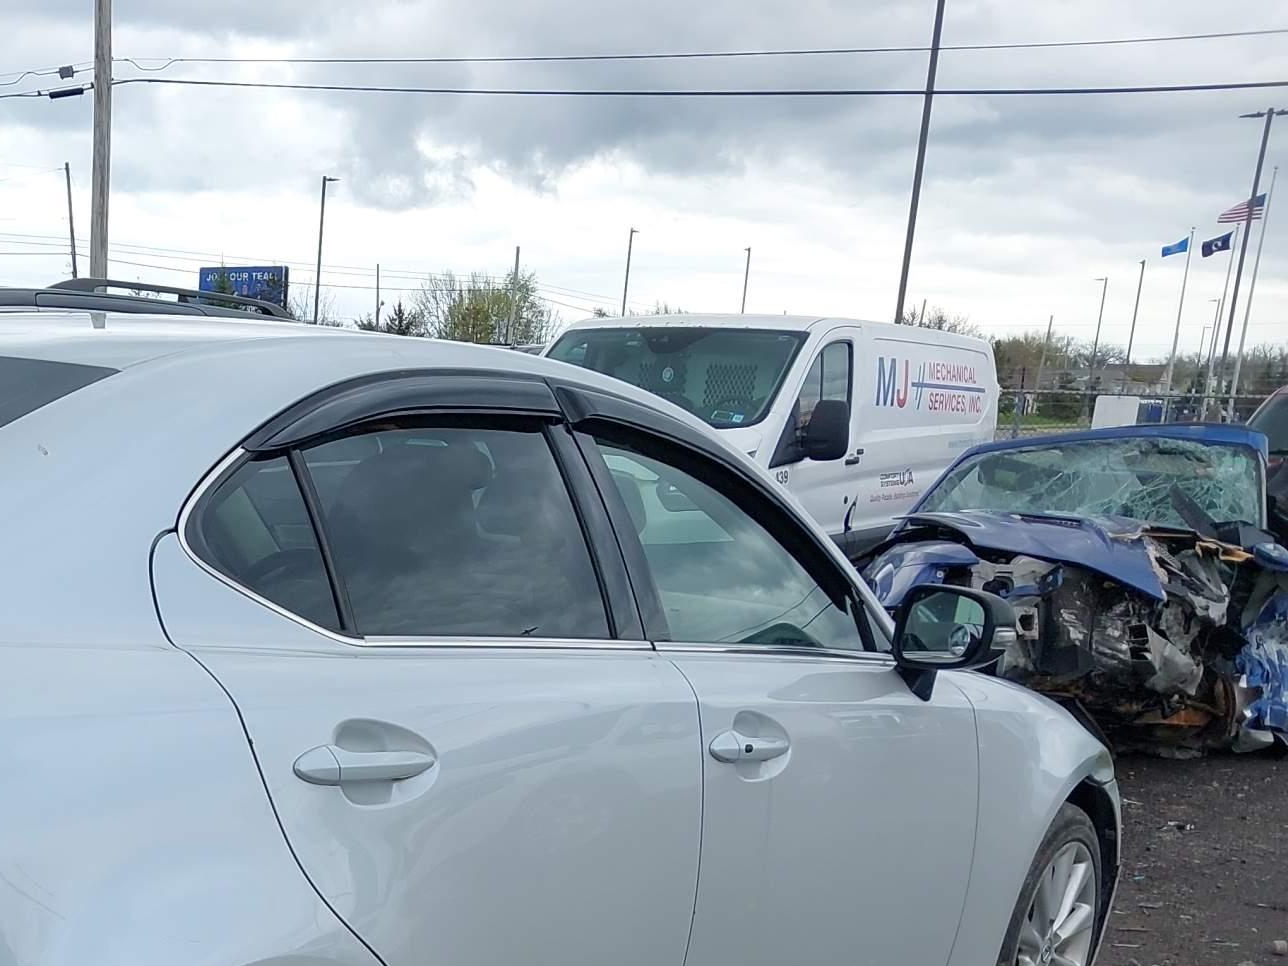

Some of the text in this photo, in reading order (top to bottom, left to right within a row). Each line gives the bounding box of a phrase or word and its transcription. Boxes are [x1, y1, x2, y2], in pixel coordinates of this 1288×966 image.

[229, 272, 249, 281] OUR
[875, 356, 909, 408] MJ
[928, 361, 977, 384] MECHANICAL
[928, 391, 982, 415] SERVICES, INC.
